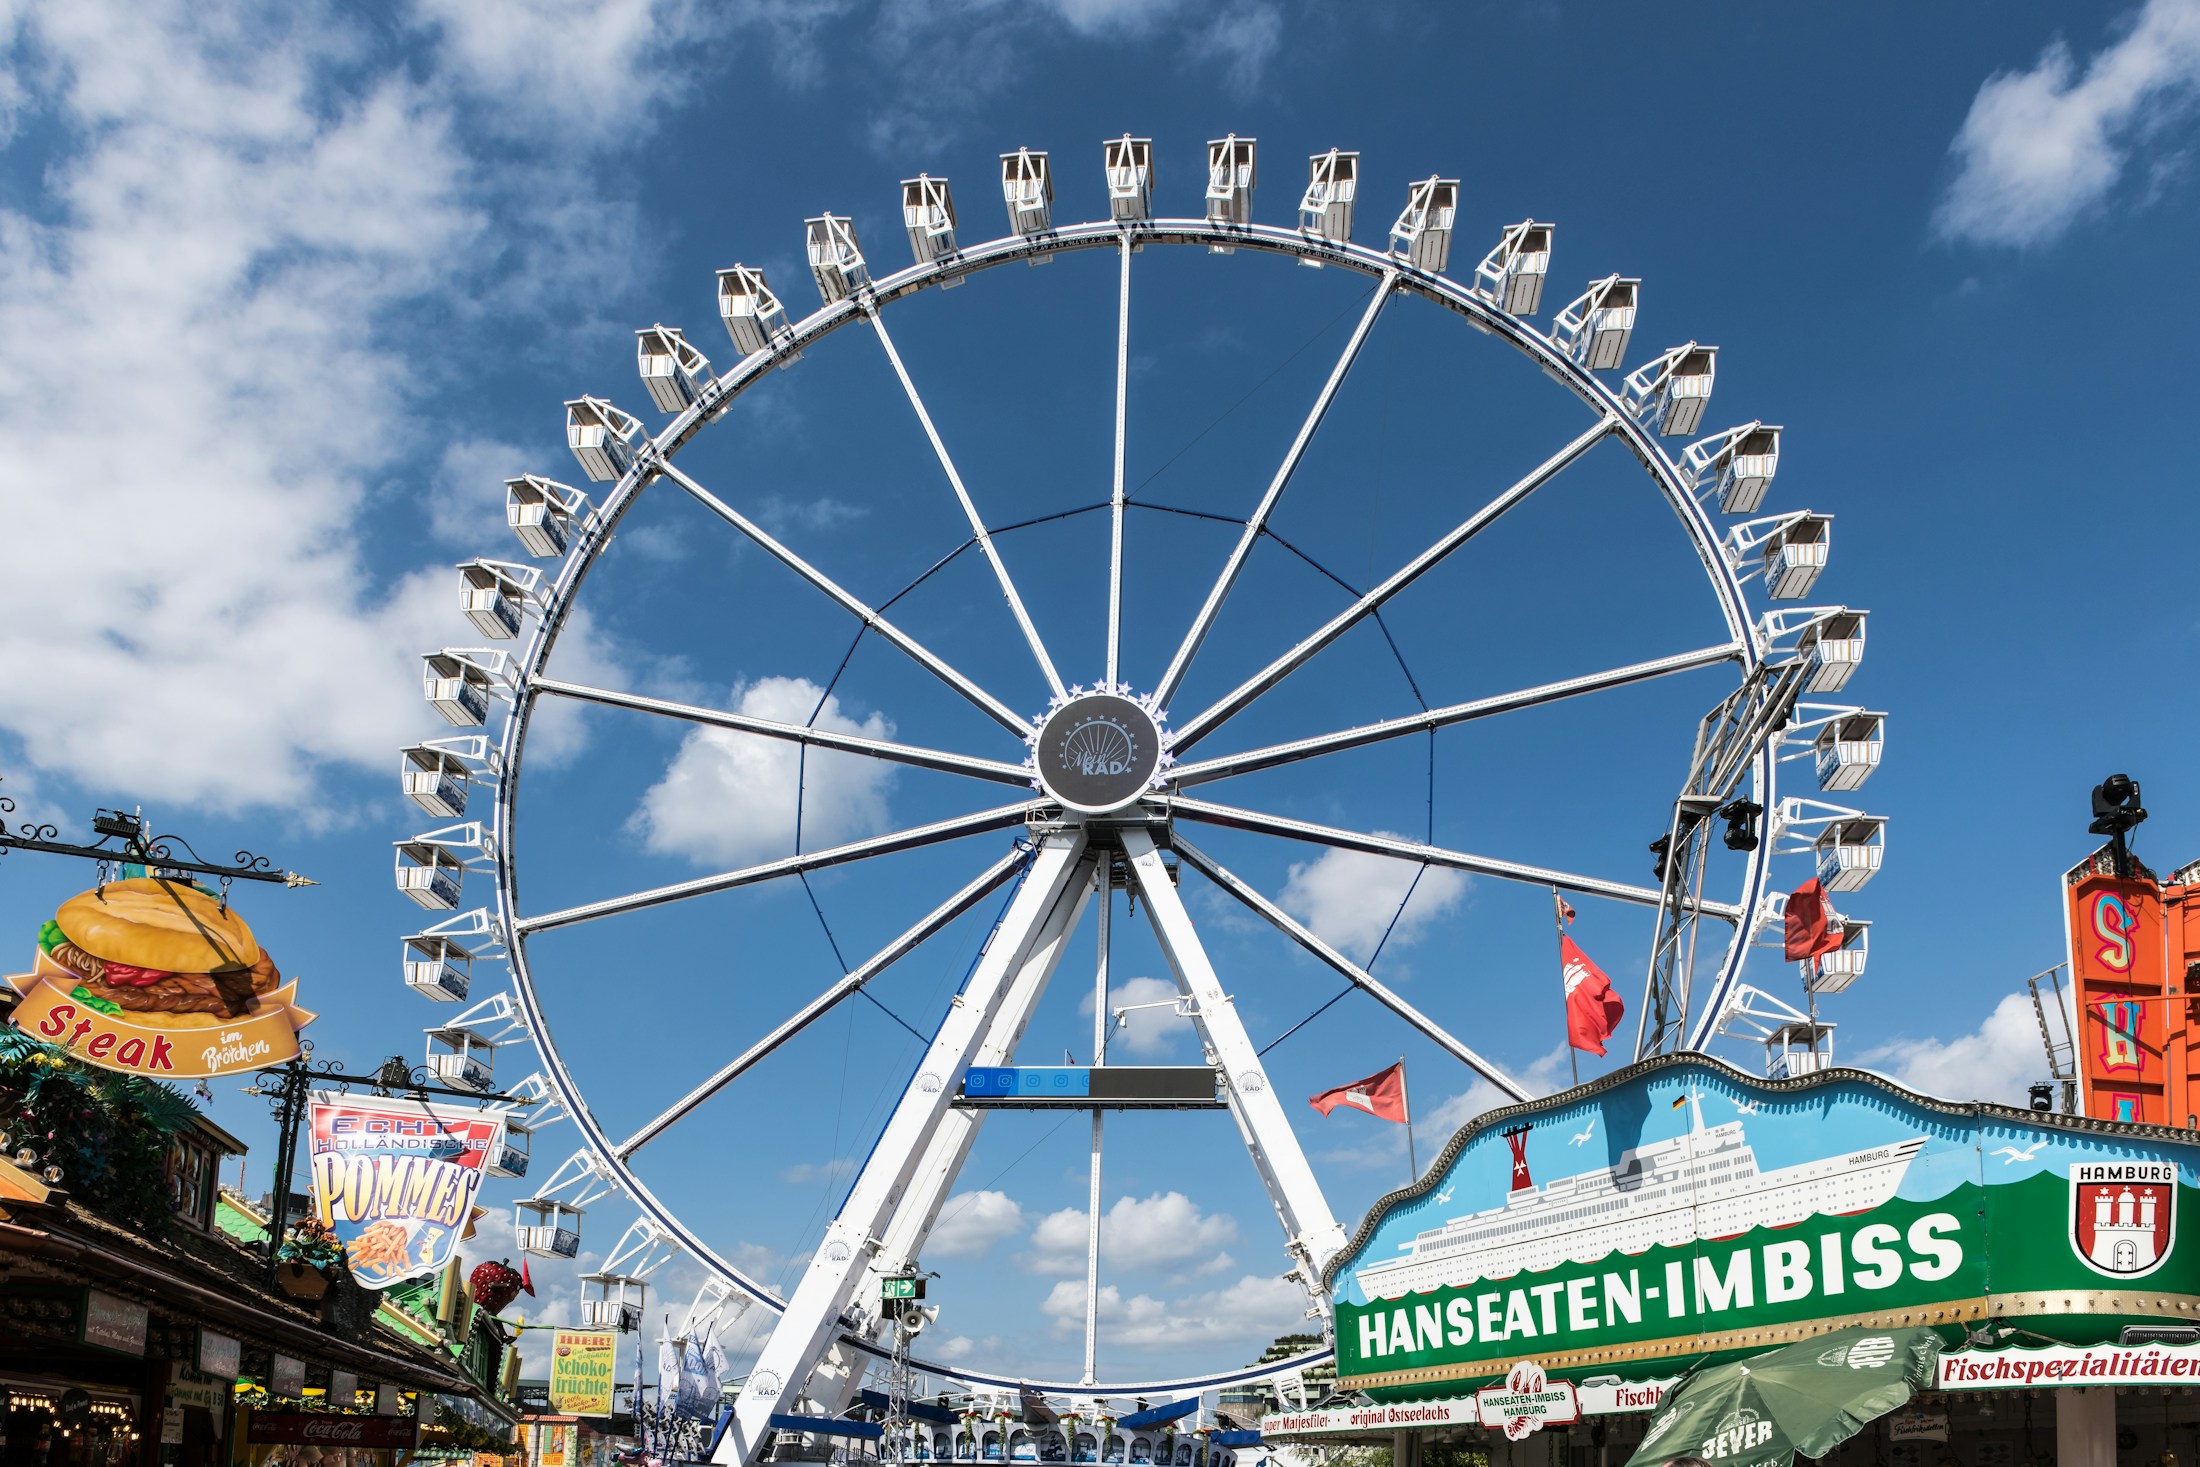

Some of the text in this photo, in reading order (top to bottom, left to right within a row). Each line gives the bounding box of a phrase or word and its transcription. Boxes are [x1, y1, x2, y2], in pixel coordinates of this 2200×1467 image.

[1071, 751, 1109, 767] Mein
[1082, 761, 1123, 775] RAD
[38, 1004, 175, 1071] Steak
[220, 1031, 243, 1042] im
[201, 1040, 270, 1073] Brötchen
[330, 1117, 454, 1135] ECHT
[1715, 1129, 1737, 1139] HAMBURG
[317, 1135, 489, 1153] HOLLÄNDISCHE
[1848, 1149, 1890, 1166] HAMBURG
[2080, 1166, 2172, 1180] HAMBURG
[313, 1150, 481, 1233] POMMES
[1358, 1212, 1964, 1359] HANSEATEN-IMBISS
[559, 1334, 612, 1347] HIER!
[557, 1358, 612, 1378] Schoko-
[555, 1376, 607, 1396] früchte
[1483, 1391, 1566, 1407] HANSEATEN-IMBISS
[1350, 1409, 1385, 1429] original
[1388, 1406, 1451, 1423] Ostseelachs
[1503, 1405, 1548, 1417] HAMBURG
[303, 1420, 365, 1440] Coca-Cola
